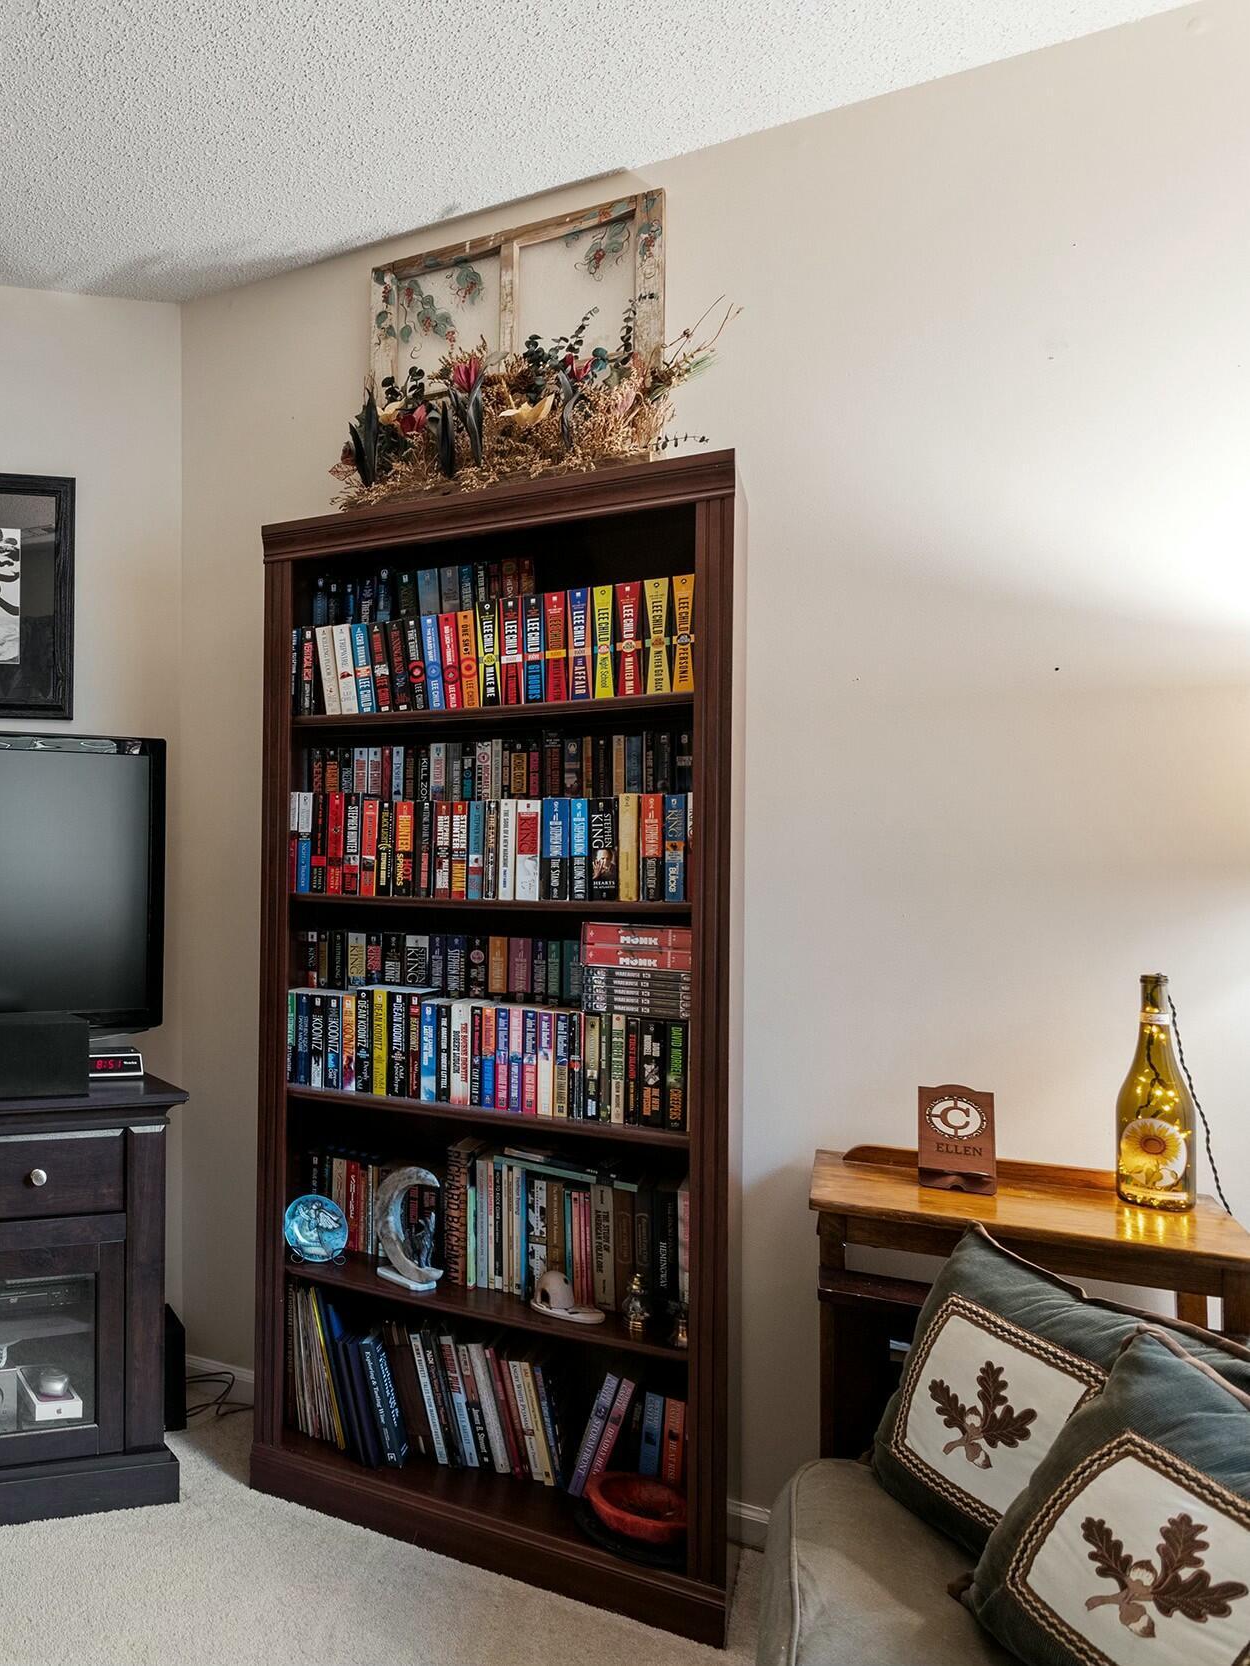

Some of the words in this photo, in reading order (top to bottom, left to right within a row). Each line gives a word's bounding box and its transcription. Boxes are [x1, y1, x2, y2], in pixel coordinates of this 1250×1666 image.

[623, 604, 634, 618] LEE
[652, 601, 663, 614] LEE
[679, 598, 689, 611] LEE
[527, 618, 539, 631] LEE
[574, 610, 585, 624] LEE
[598, 608, 608, 622] LEE
[652, 615, 663, 635] CHILD
[679, 611, 689, 632] CHILD
[461, 624, 470, 637] ONE
[483, 620, 493, 633] LEE
[504, 620, 517, 635] LEE
[574, 625, 585, 647] CHILD
[598, 622, 608, 642] CHILD
[624, 619, 634, 639] CHILD
[484, 633, 494, 653] CHILD
[505, 635, 517, 655] CHILD
[527, 631, 539, 652] CHILD
[528, 665, 540, 674] 61
[678, 648, 688, 683] PERSONAL
[359, 678, 370, 689] LEE
[431, 680, 440, 690] LEE
[485, 667, 495, 686] MAKE
[574, 666, 586, 695] AFFAIR
[415, 683, 424, 694] LEE
[486, 687, 495, 697] ME
[528, 675, 540, 700] HOURS
[432, 691, 441, 707] CHILD
[449, 694, 457, 708] CHILD
[420, 758, 428, 780] KILL
[347, 806, 359, 830] STEPHEN
[667, 810, 678, 838] KING
[398, 820, 412, 851] HUNTER
[520, 817, 531, 852] KING
[550, 825, 562, 844] STEPHEN
[574, 822, 585, 841] STEPHEN
[591, 814, 604, 849] KING
[604, 814, 613, 848] STEPHEN
[346, 831, 358, 853] HUNTER
[551, 858, 560, 869] THE
[551, 870, 560, 886] STAND
[350, 946, 358, 975] KING
[406, 948, 419, 984] KING
[418, 948, 426, 984] STEPHEN
[448, 949, 460, 974] STEPHEN
[385, 961, 395, 982] KING
[358, 1000, 367, 1019] DEAN
[374, 1003, 383, 1022] DEAN
[392, 1003, 402, 1022] DEAN
[311, 1018, 323, 1051] KOONTZ
[327, 1021, 339, 1053] KOONTZ
[357, 1019, 367, 1048] KOONTZ
[374, 1024, 383, 1051] KOONTZ
[392, 1023, 403, 1051] KOONTZ
[612, 1029, 624, 1039] THE
[672, 1027, 684, 1047] DAVID
[629, 1034, 637, 1054] FIRST
[670, 1088, 683, 1120] CREEPERS
[935, 1142, 983, 1157] ELLEN
[446, 1150, 460, 1211] RICHARD
[446, 1214, 461, 1285] BACHMAN
[659, 1241, 668, 1288] HEMINGWAY
[364, 1351, 376, 1380] Exploring
[449, 1376, 462, 1394] PILOT
[585, 1418, 600, 1448] STORM
[598, 1428, 615, 1456] DEADLY
[478, 1433, 487, 1454] Stewart
[577, 1448, 594, 1476] FRONT
